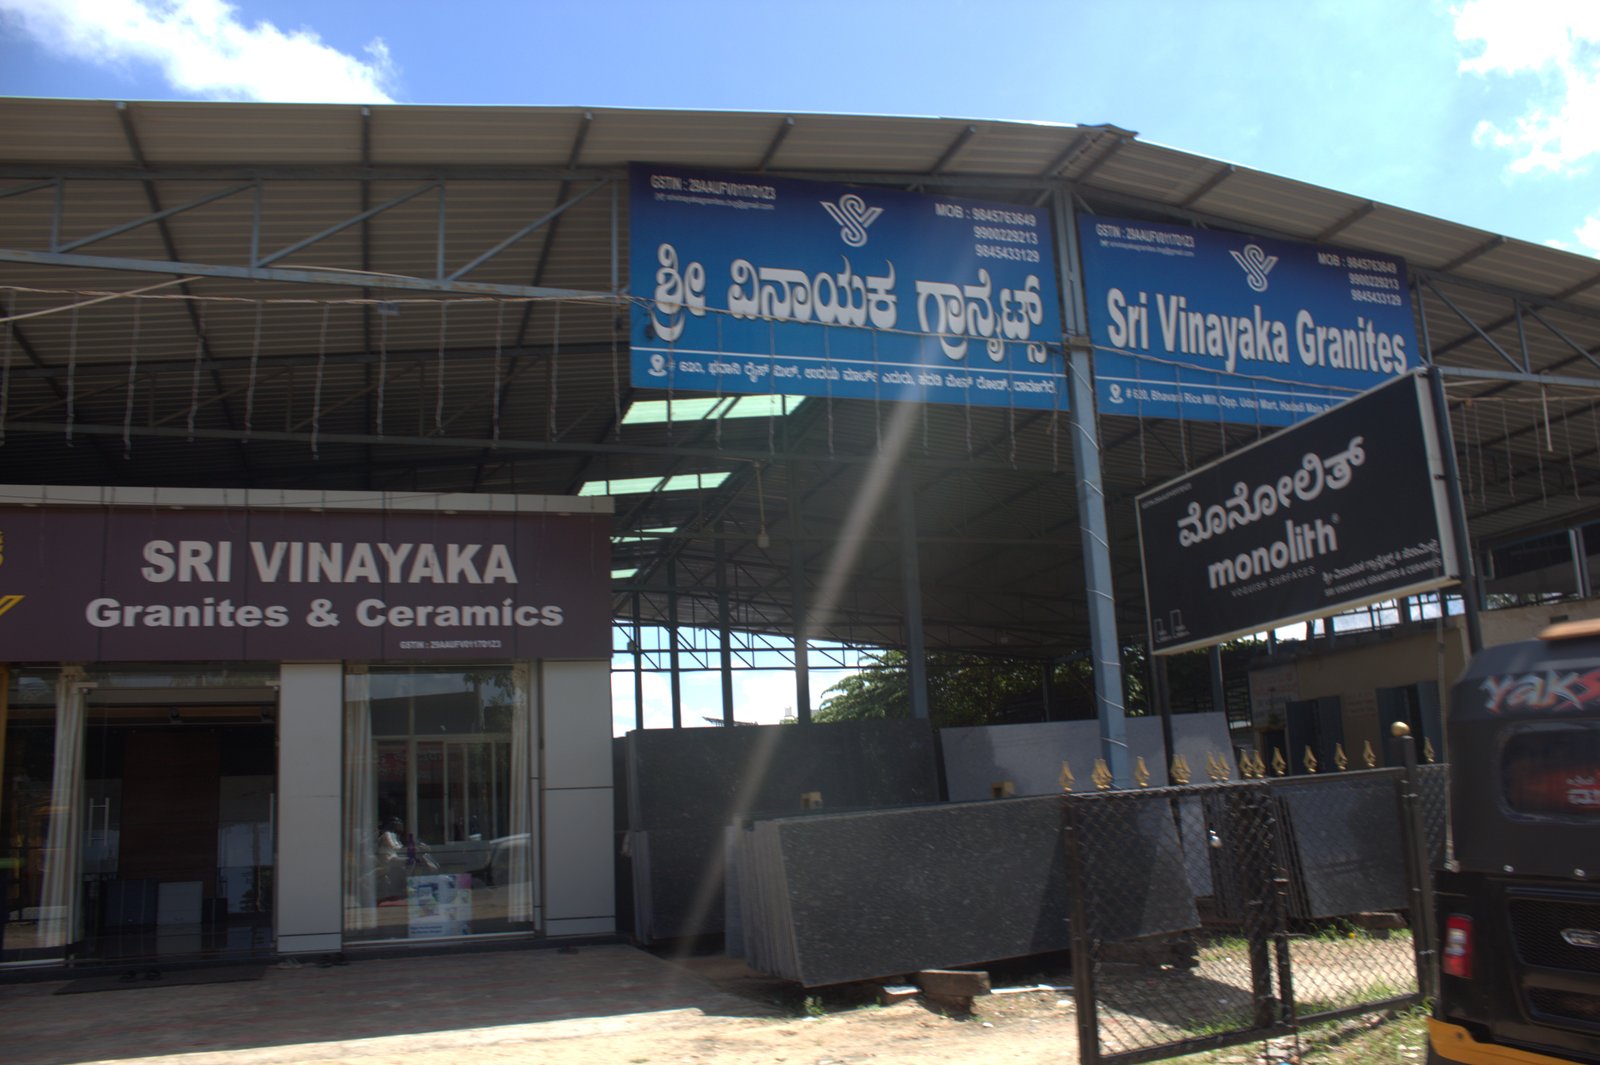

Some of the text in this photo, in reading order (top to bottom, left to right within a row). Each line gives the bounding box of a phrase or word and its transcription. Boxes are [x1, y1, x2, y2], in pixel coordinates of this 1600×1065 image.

[934, 203, 964, 218] MOB
[1317, 252, 1340, 267] MOB
[651, 243, 706, 341] ಶ್ರೀ
[728, 255, 898, 331] ವಿನಾಯಕ
[1107, 287, 1407, 375] Sri Vinayaka Granites
[141, 540, 518, 583] SRI VINAYAKA
[1208, 518, 1338, 589] monolith
[86, 597, 564, 627] Granites & Ceramics
